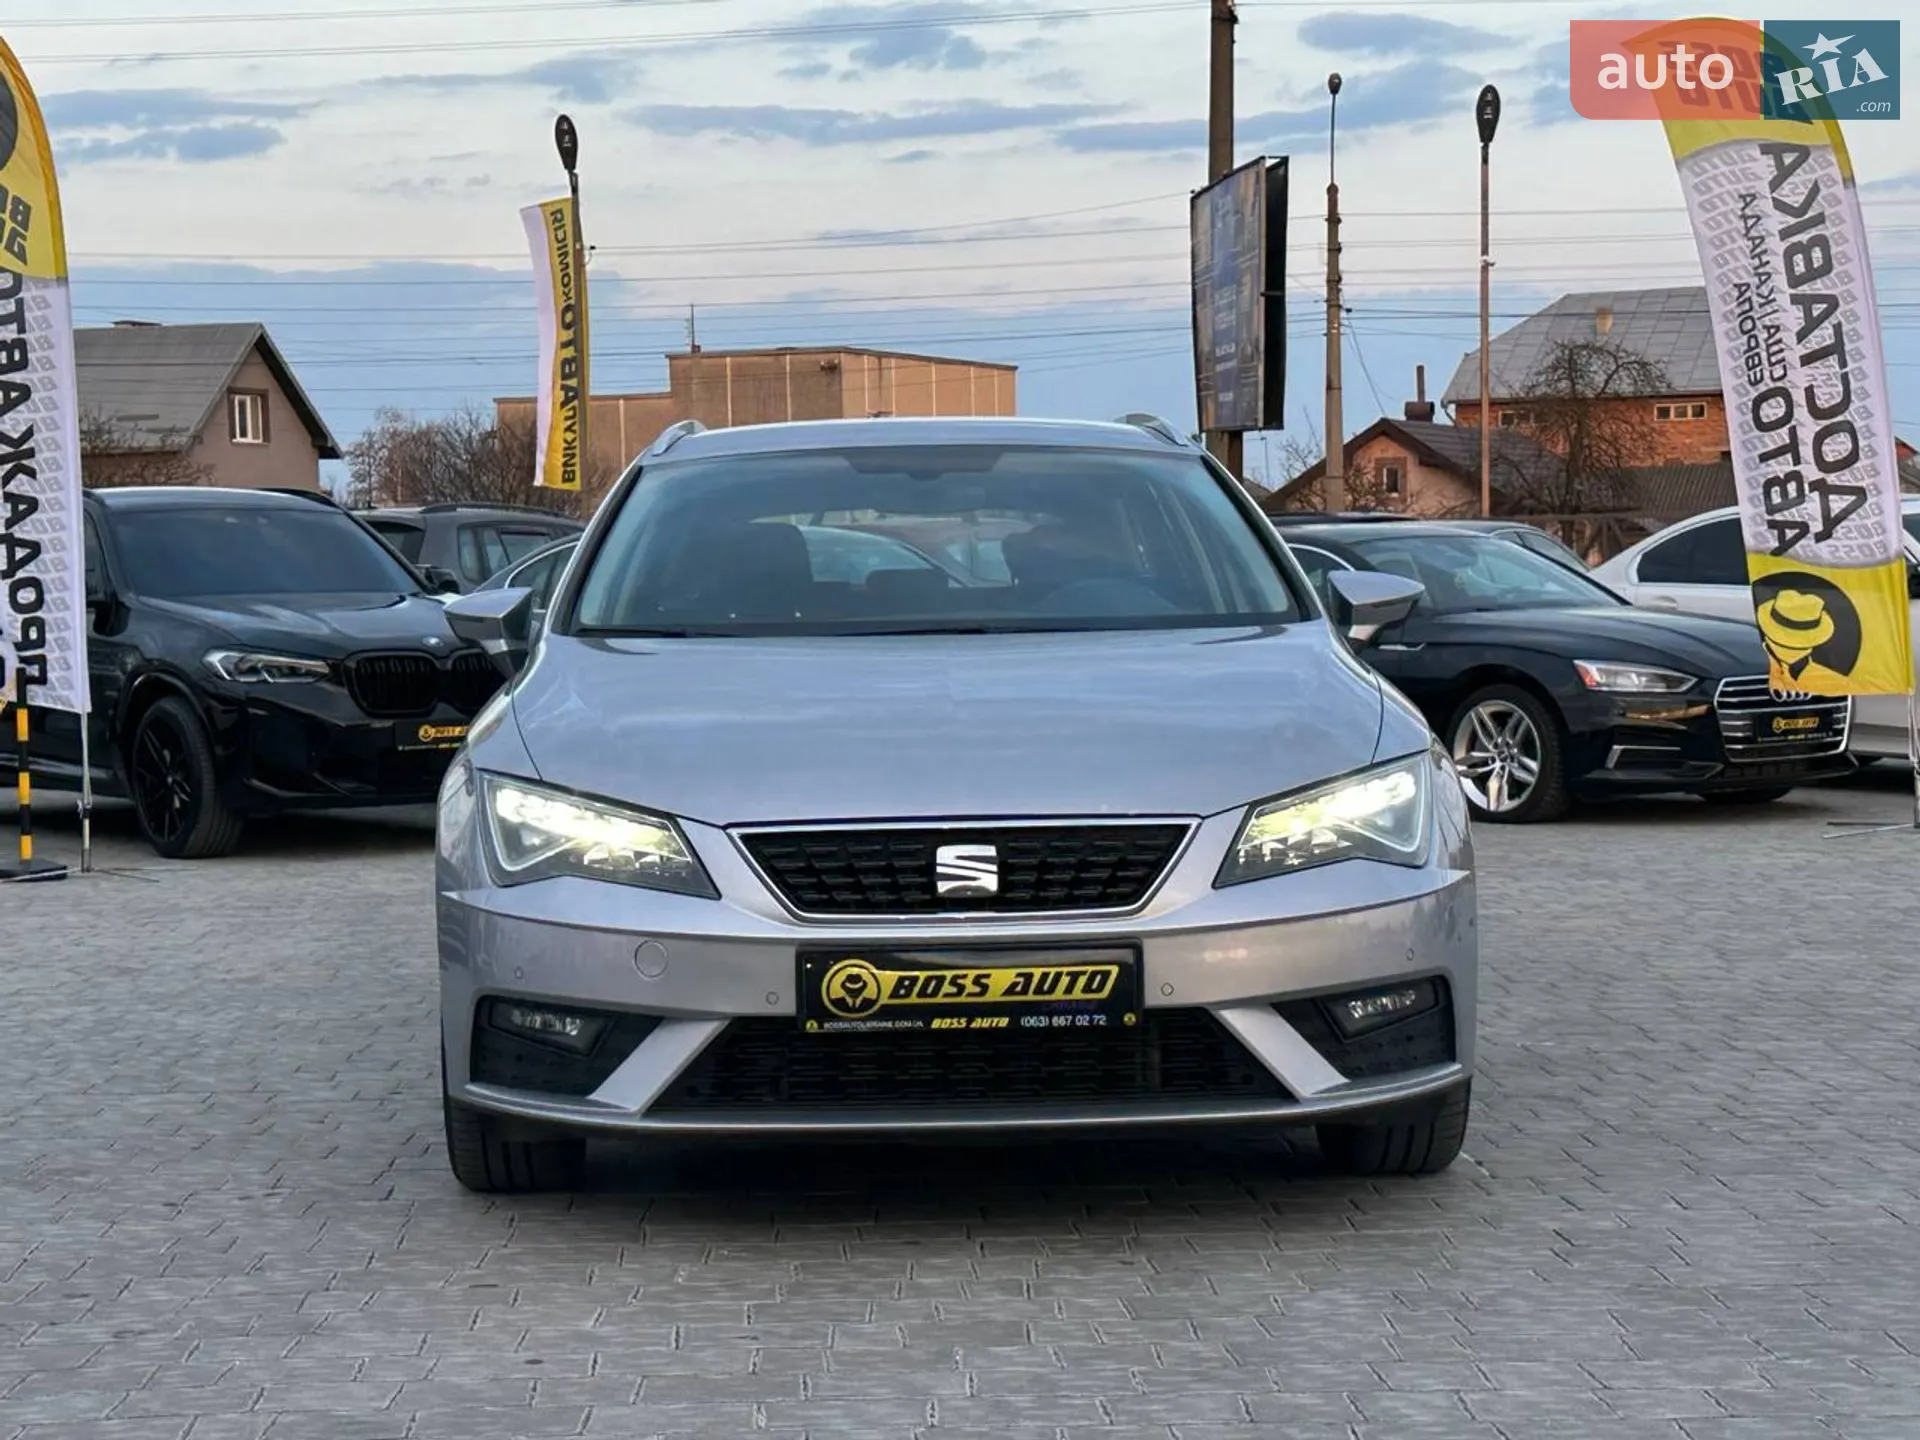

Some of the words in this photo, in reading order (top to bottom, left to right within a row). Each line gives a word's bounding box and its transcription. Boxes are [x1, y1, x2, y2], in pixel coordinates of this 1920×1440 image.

[888, 973, 992, 1000] BOSS
[1000, 969, 1113, 997] AUTO
[931, 1017, 968, 1029] BOSS
[969, 1016, 1009, 1028] AUTO
[1020, 1015, 1050, 1027] (063)
[1051, 1014, 1073, 1027] 667
[1075, 1014, 1090, 1026] 02
[1092, 1013, 1108, 1026] 72
